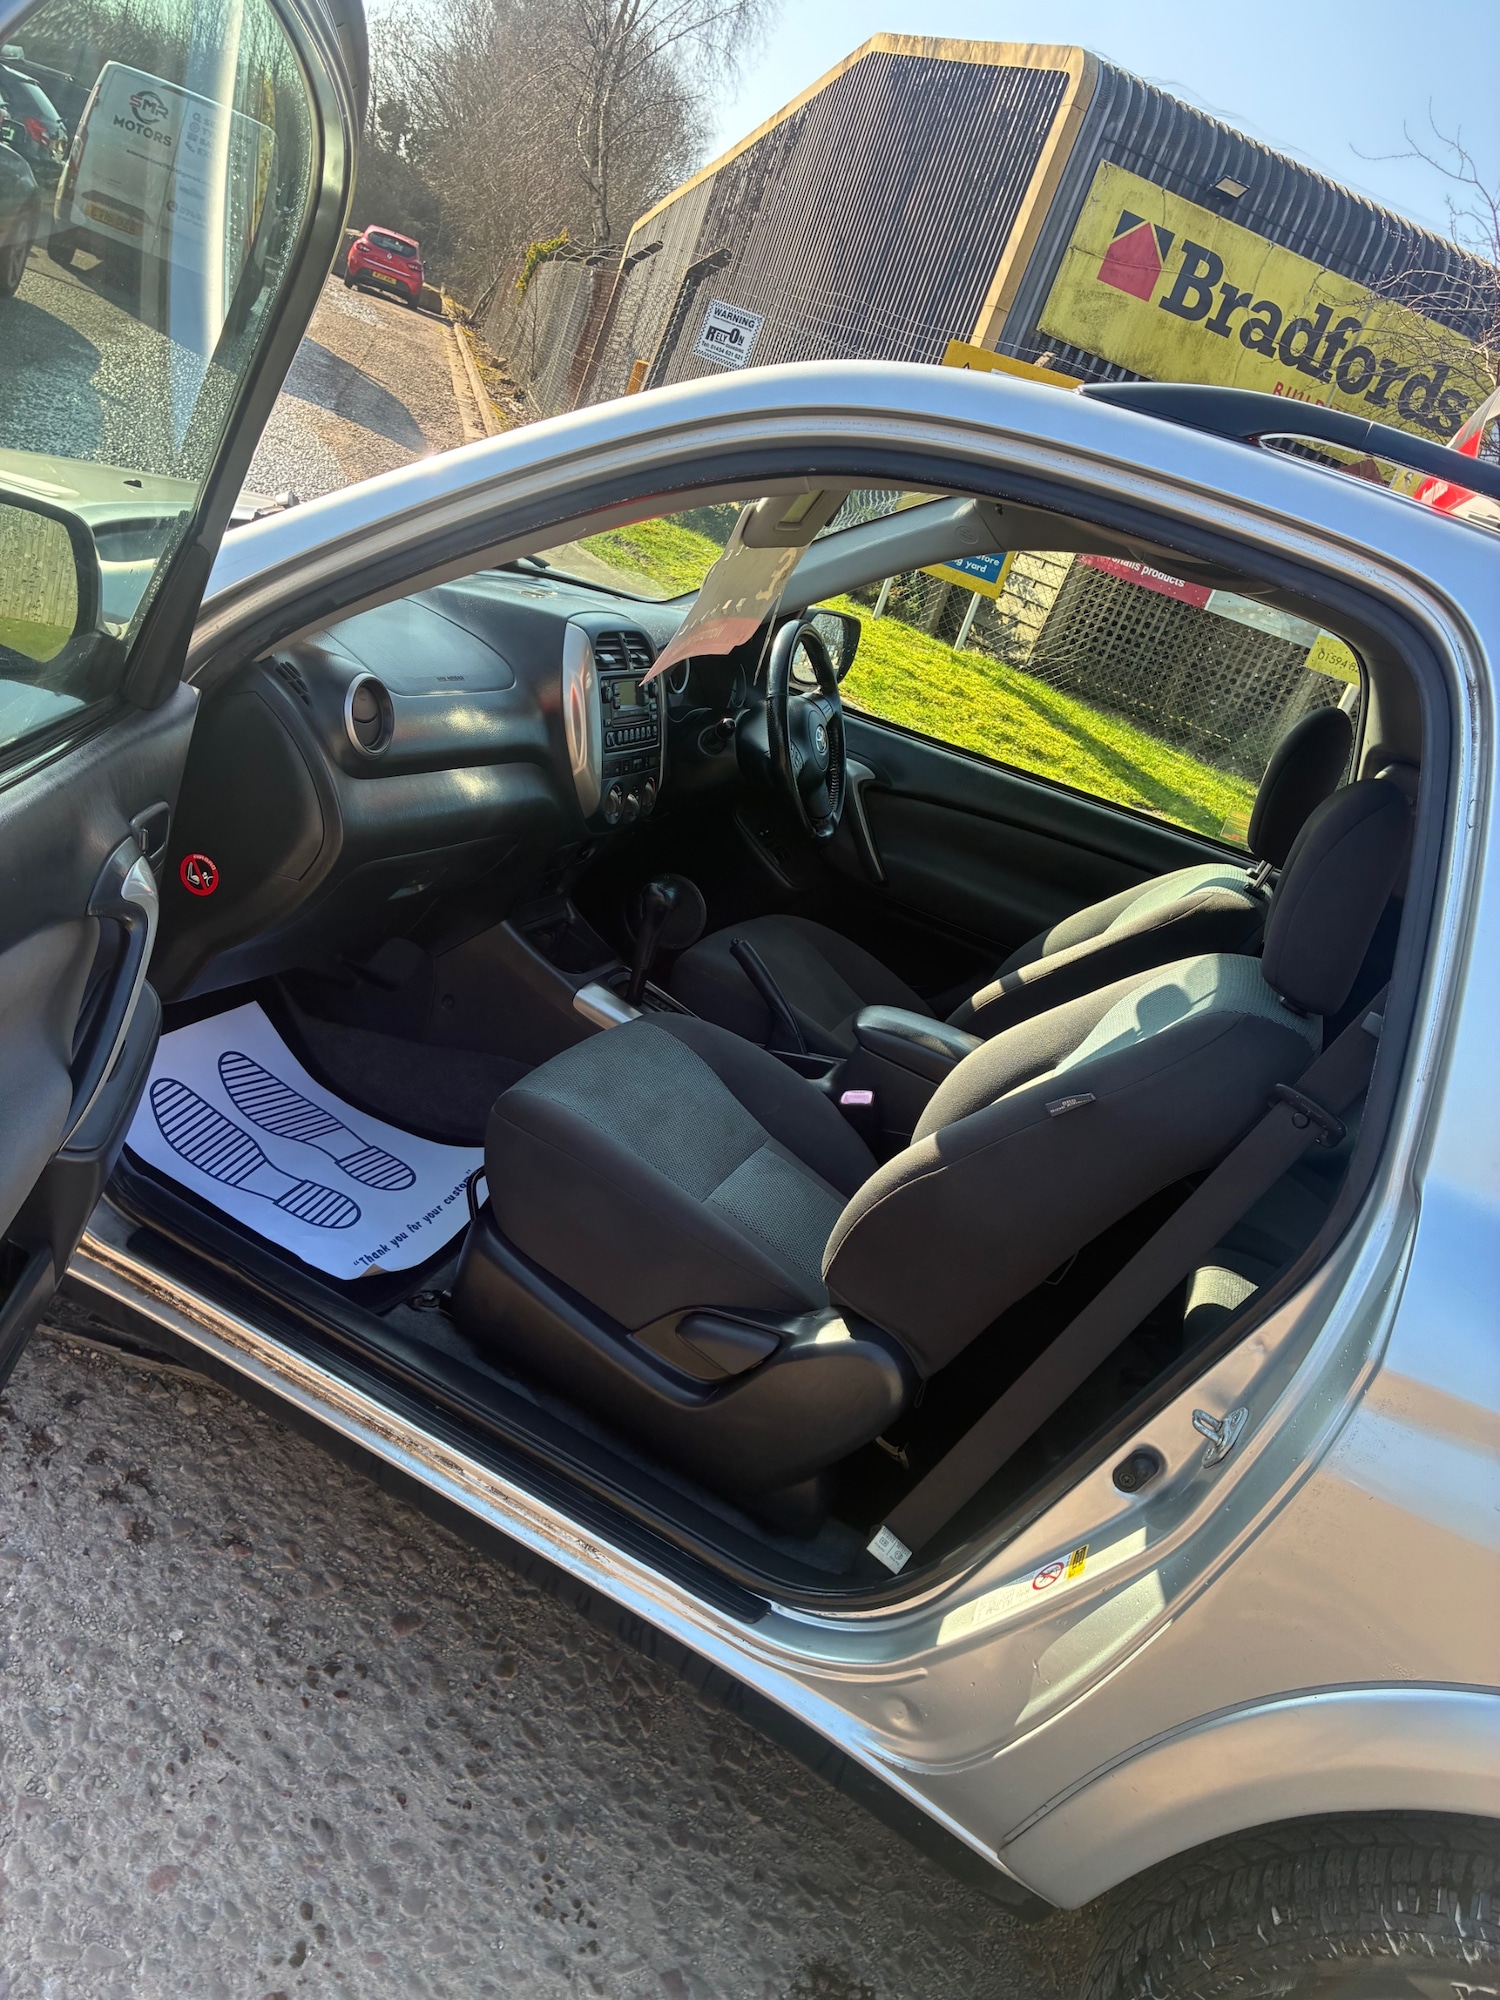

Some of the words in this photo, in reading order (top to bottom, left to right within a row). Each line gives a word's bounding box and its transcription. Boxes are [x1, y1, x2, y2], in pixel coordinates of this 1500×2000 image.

[129, 94, 169, 120] SMR
[113, 115, 172, 147] MOTORS
[714, 307, 755, 329] WARNING
[1158, 240, 1472, 437] Bradfords
[965, 560, 988, 573] yard
[1141, 565, 1186, 588] products
[1318, 650, 1348, 668] 01594
[389, 1231, 409, 1248] you
[406, 1221, 423, 1233] for
[422, 1204, 444, 1224] your
